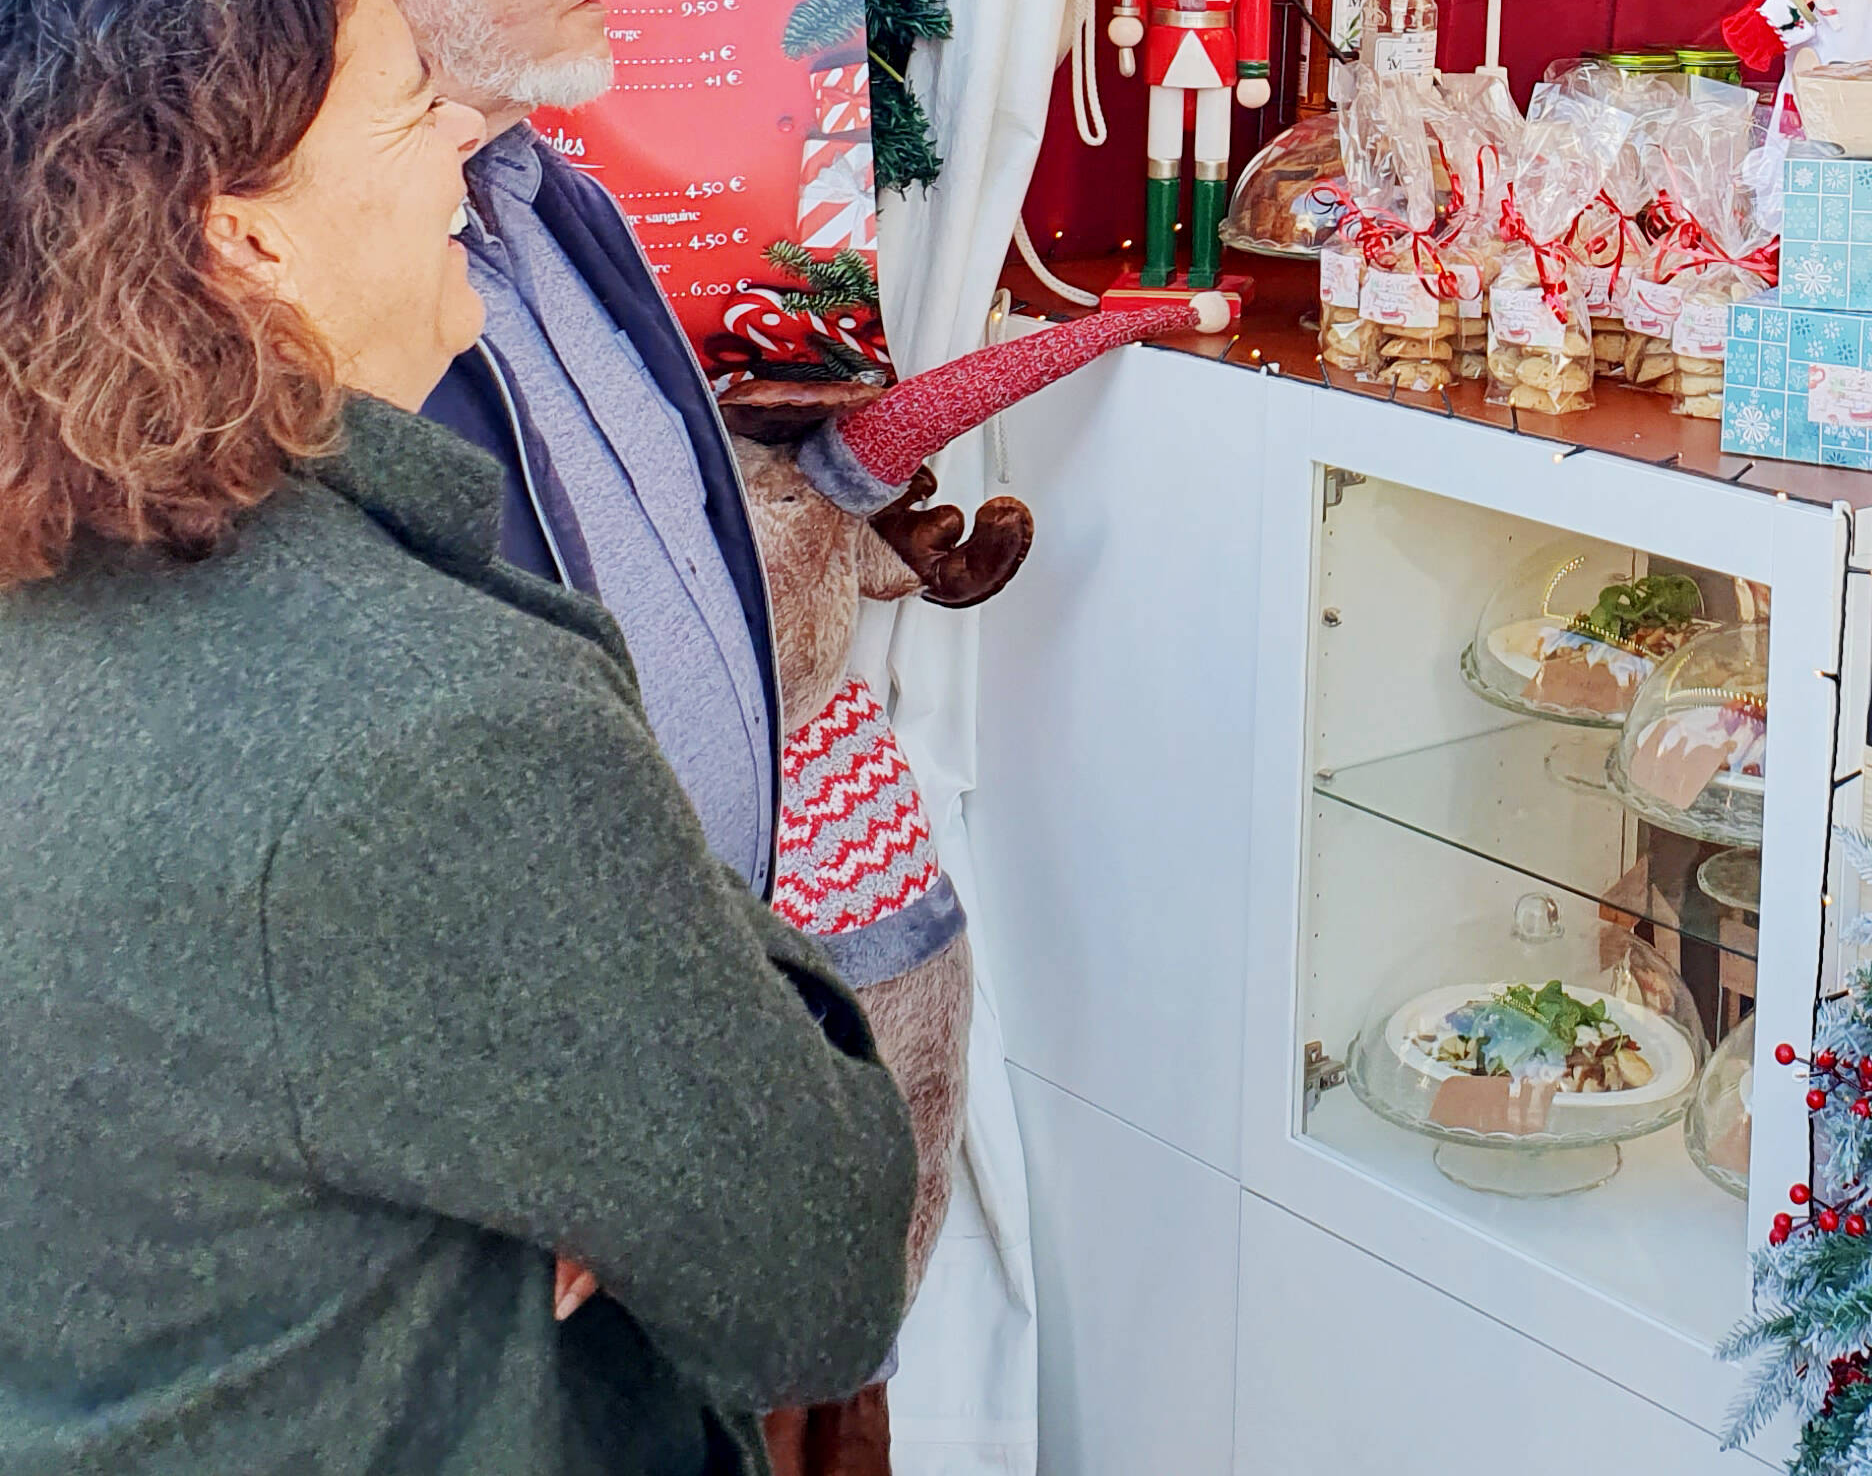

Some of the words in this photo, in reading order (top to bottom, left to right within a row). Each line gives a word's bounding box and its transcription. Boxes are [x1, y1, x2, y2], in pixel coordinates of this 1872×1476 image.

[681, 0, 718, 18] 9.50
[645, 209, 700, 225] sanguine
[690, 281, 731, 296] 6.00
